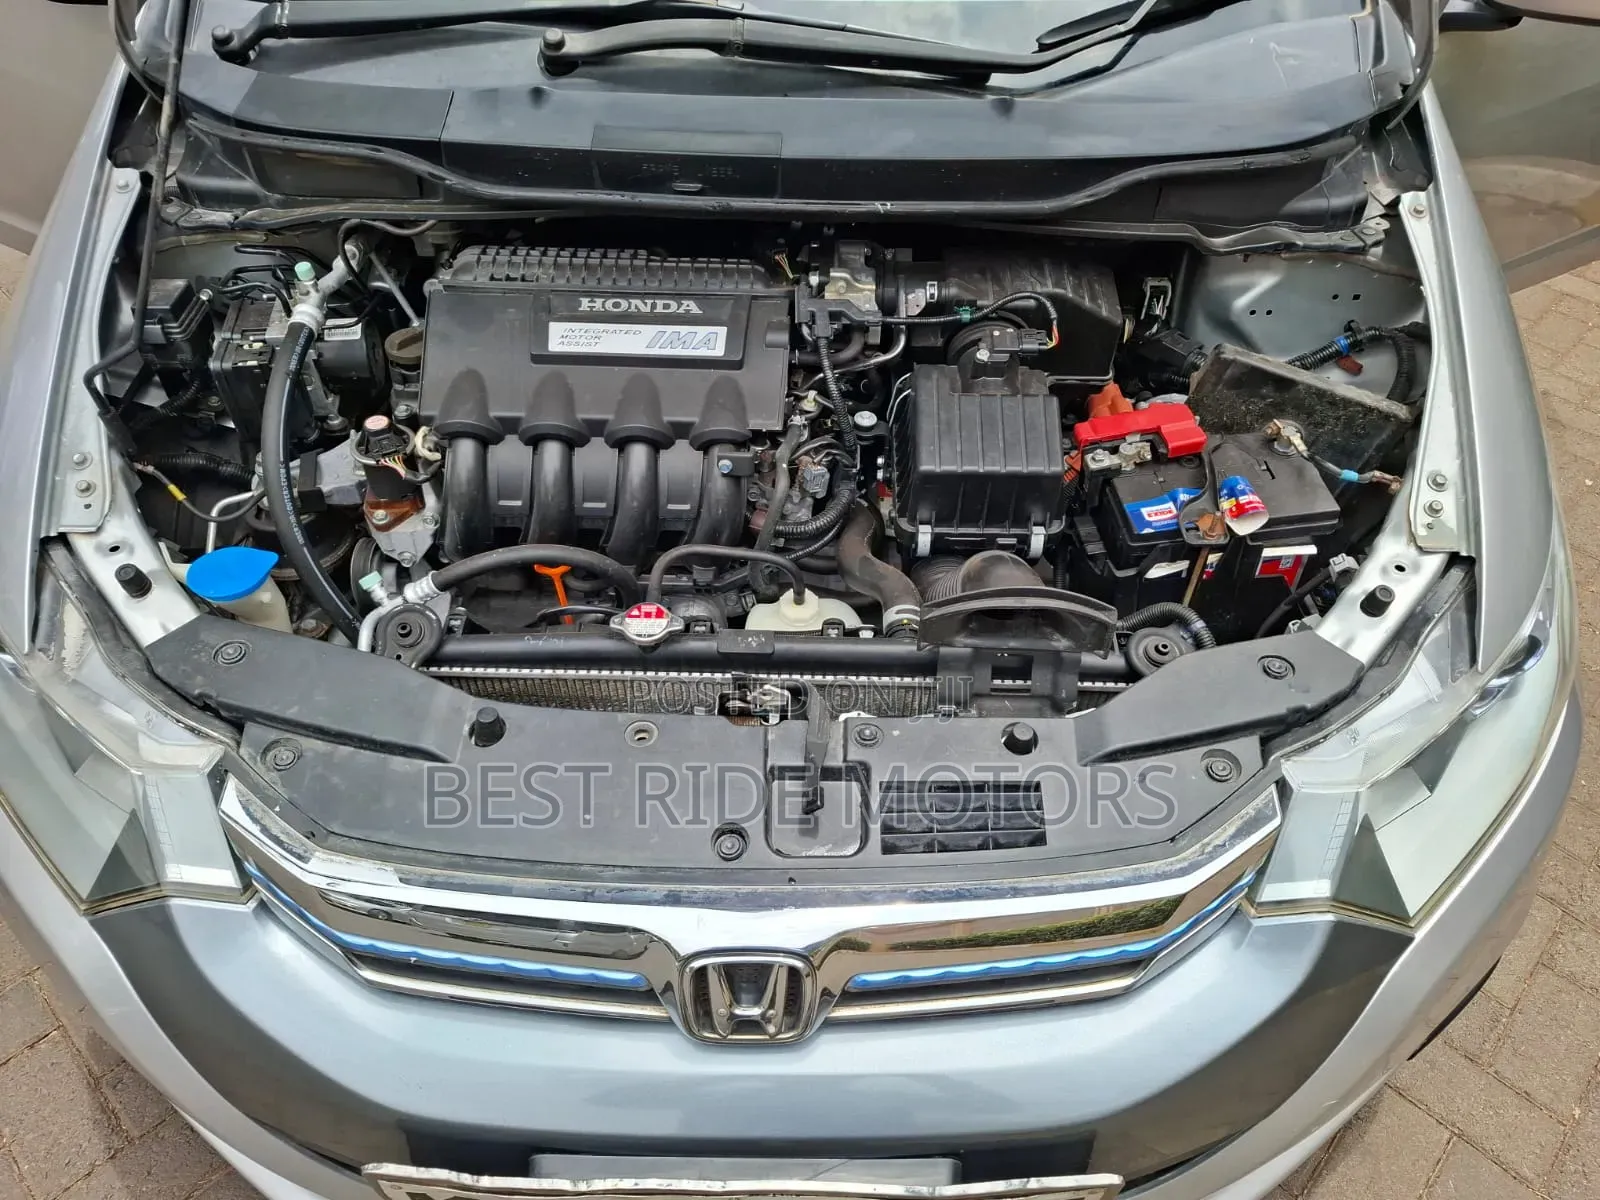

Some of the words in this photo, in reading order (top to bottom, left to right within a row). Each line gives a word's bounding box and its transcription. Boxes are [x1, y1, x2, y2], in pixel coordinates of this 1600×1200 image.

[578, 297, 703, 314] HONDA
[563, 327, 642, 336] INTEGRATED
[557, 340, 601, 348] ASSIST
[646, 330, 719, 351] IMA
